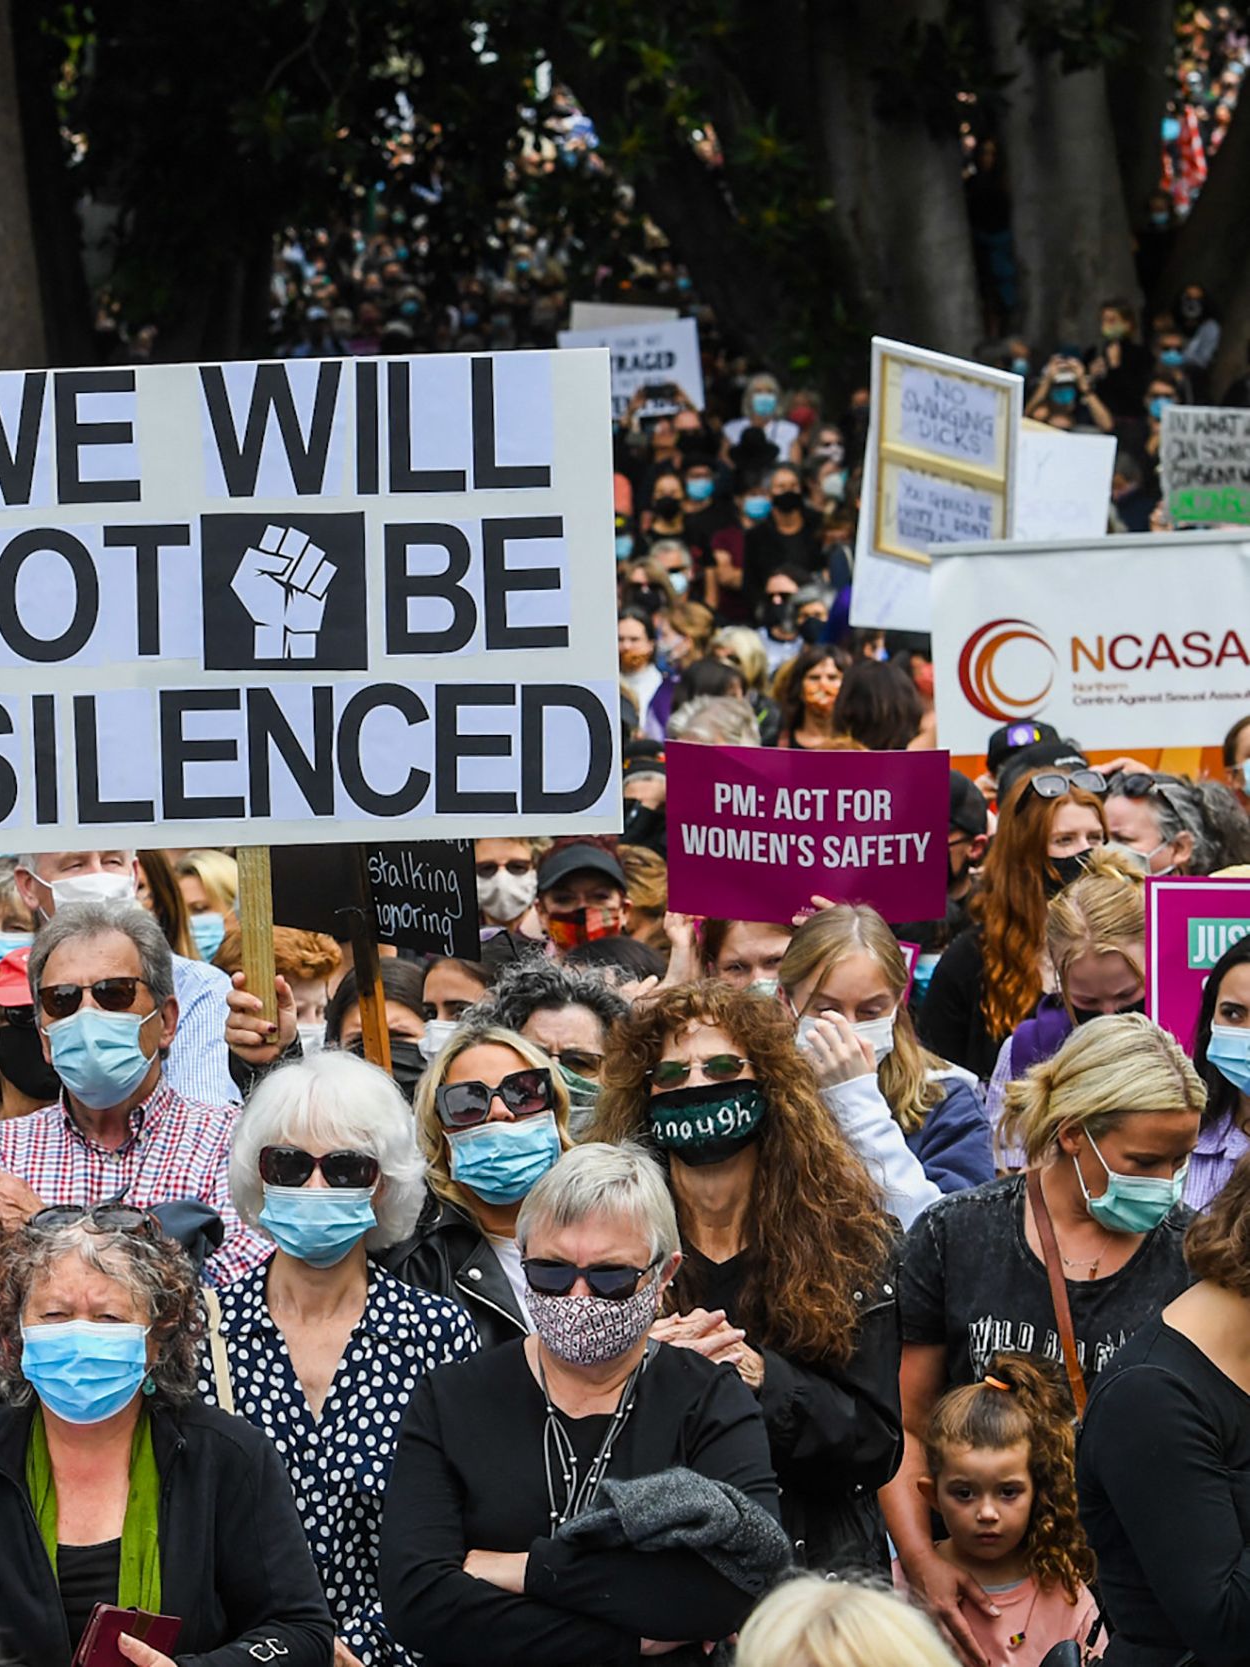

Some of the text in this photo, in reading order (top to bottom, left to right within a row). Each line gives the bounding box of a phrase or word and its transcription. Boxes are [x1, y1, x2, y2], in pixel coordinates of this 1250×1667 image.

[934, 379, 966, 406] NO
[199, 357, 551, 497] WILL
[918, 418, 981, 456] DICKS
[384, 515, 569, 655] BE
[1071, 630, 1250, 673] NCASA
[714, 782, 892, 822] PM: ACT FOR
[681, 823, 932, 869] WOMEN'S SAFETY
[374, 896, 455, 957] ignoring
[1193, 924, 1250, 964] JUS
[968, 1314, 1035, 1355] WILD
